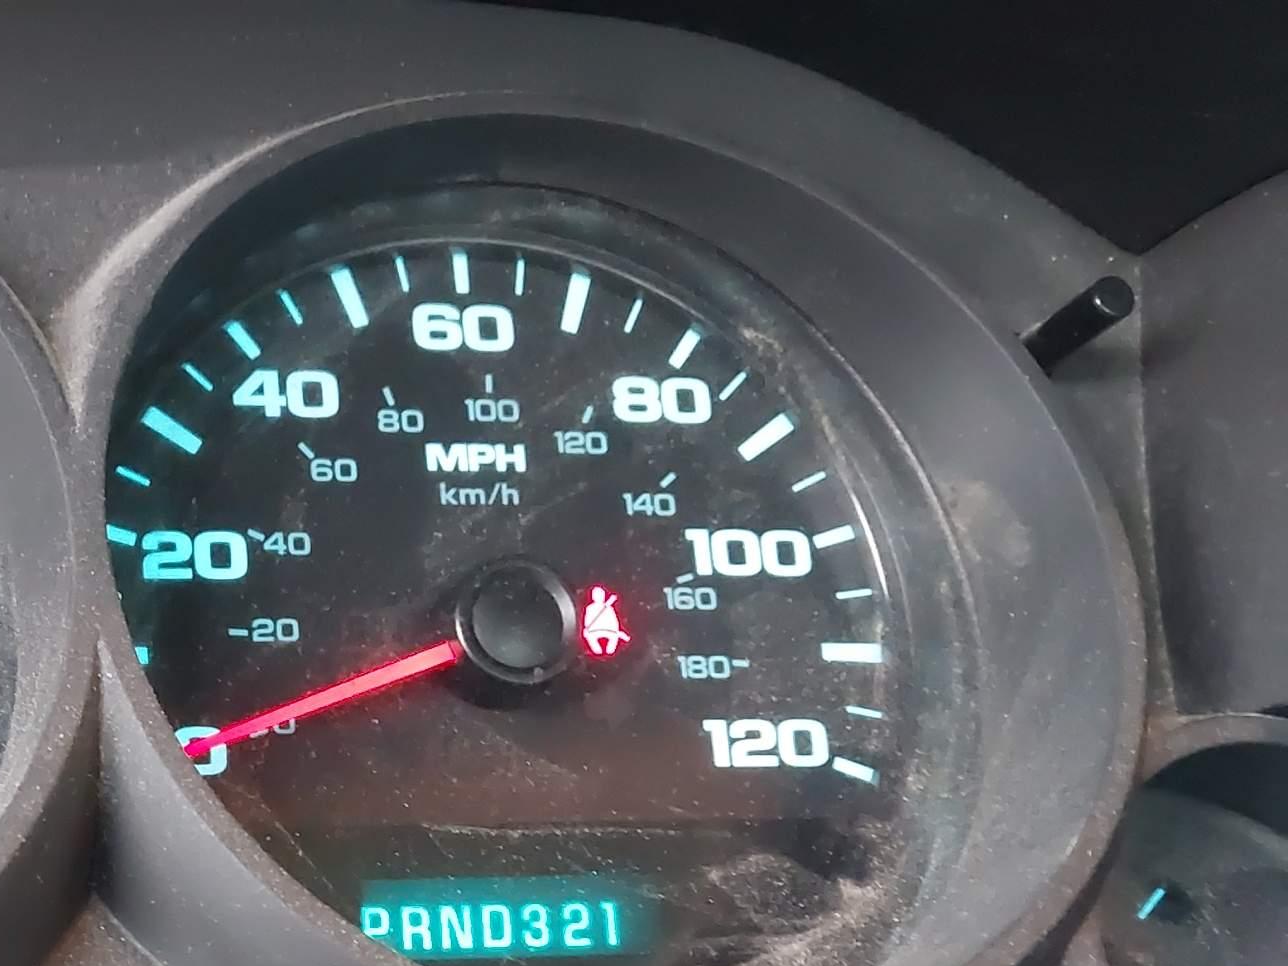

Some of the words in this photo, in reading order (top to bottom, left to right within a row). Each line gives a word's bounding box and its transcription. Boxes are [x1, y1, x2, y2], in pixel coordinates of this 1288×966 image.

[412, 303, 514, 352] 60
[233, 370, 339, 418] 40
[612, 376, 711, 424] 80
[378, 410, 423, 432] 80
[465, 399, 519, 422] 100
[554, 432, 607, 454] 120
[426, 443, 526, 472] MPH
[311, 459, 357, 481] 60
[440, 483, 519, 505] km/h
[623, 494, 675, 516] 140
[142, 531, 247, 579] 20
[261, 532, 310, 555] 40
[684, 529, 812, 577] 100
[664, 587, 717, 610] 160
[252, 619, 299, 642] 20
[677, 656, 730, 678] 180
[703, 719, 829, 767] 120
